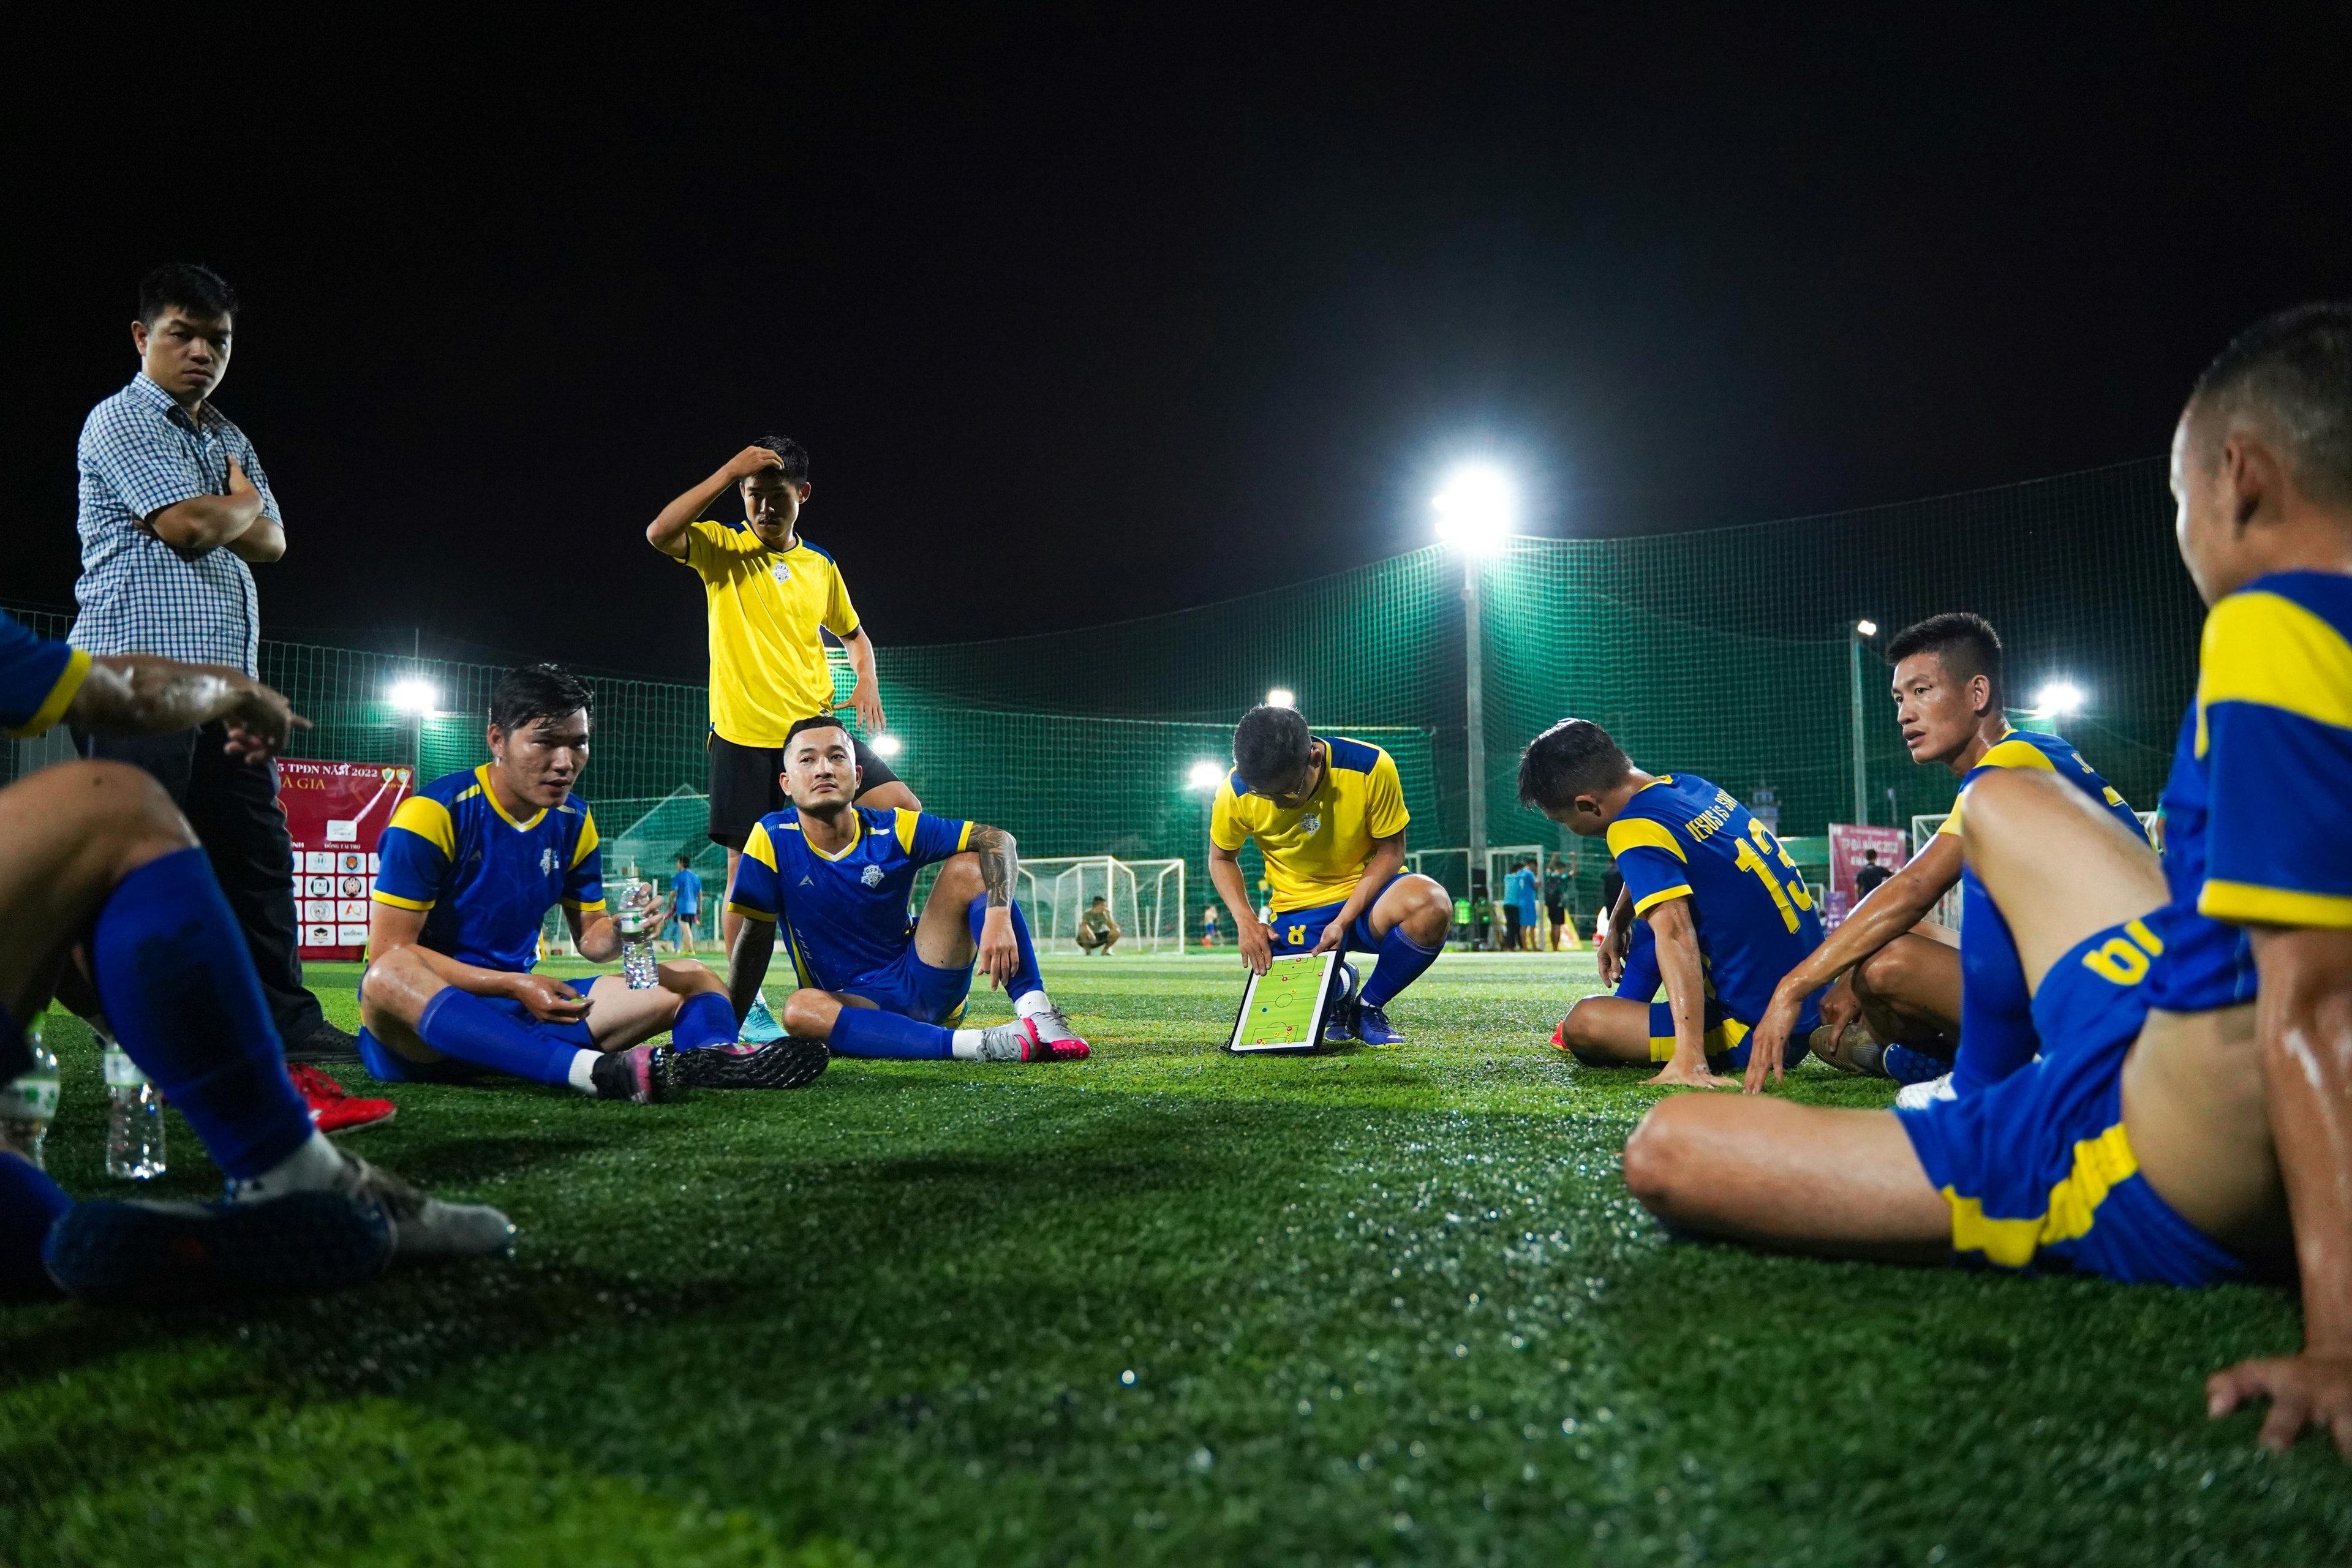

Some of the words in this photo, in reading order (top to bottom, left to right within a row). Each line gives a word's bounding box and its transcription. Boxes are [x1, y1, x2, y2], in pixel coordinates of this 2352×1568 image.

[352, 767, 378, 777] 2022
[296, 778, 325, 790] GIA
[1685, 810, 1724, 842] JESUS
[1735, 817, 1813, 934] 13
